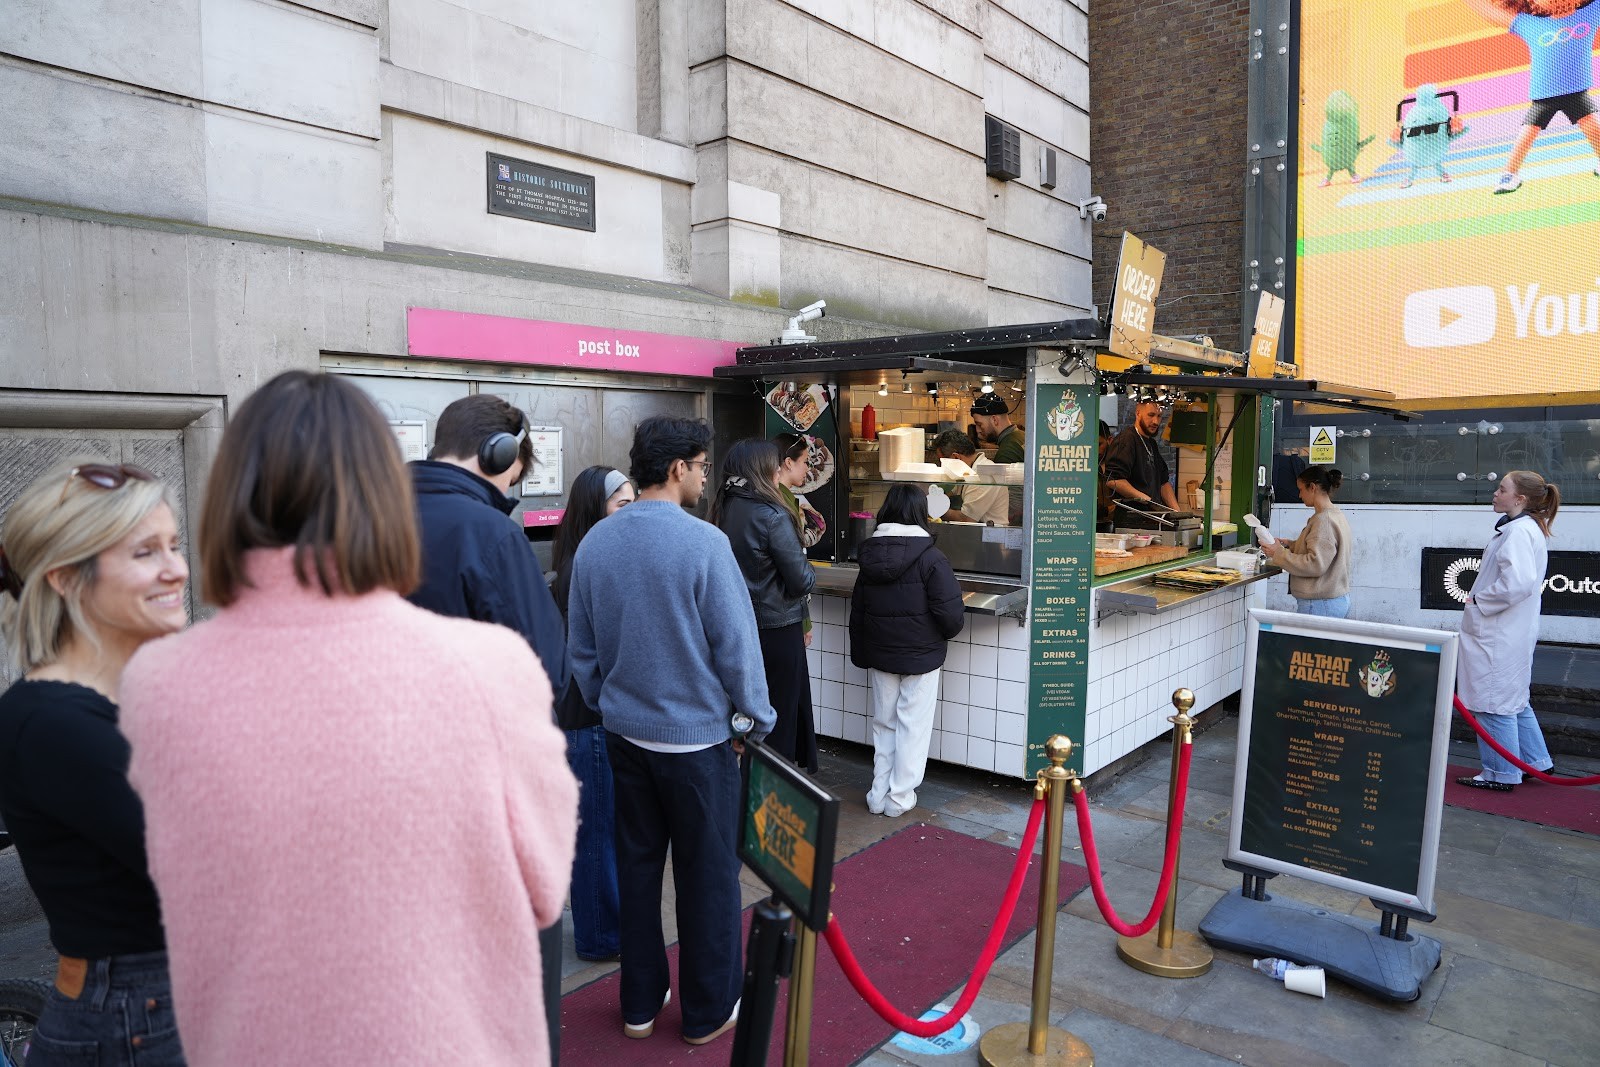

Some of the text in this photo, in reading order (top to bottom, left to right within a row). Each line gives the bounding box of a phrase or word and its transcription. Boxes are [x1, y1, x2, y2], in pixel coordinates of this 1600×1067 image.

[513, 171, 587, 196] HISTORIC SOUTHWARK
[524, 190, 543, 198] THOMAS
[518, 200, 544, 210] PRODUCED
[524, 196, 544, 204] PRINTED
[570, 206, 588, 214] ENGLISH
[1122, 264, 1156, 302] ORDER
[1505, 276, 1600, 339] You
[1120, 298, 1148, 332] HERE
[1258, 316, 1279, 340] COLLECT
[578, 338, 640, 358] post box
[1256, 340, 1273, 358] HERE
[1038, 458, 1092, 472] FALAFEL
[1289, 664, 1350, 688] FALAFEL
[1304, 700, 1360, 715] SERVED WITH
[1288, 707, 1392, 729] Hummus, Tomato, Lettuce, Carrot,
[1302, 716, 1321, 726] Turnip,
[1324, 720, 1341, 728] Tahini
[1343, 723, 1363, 732] Sauce,
[1365, 726, 1381, 735] Chilli
[1290, 738, 1314, 746] FALAFEL
[1314, 732, 1344, 744] WRAPS
[1289, 745, 1313, 753] FALAFEL
[1288, 758, 1316, 767] HALLOUMI
[1287, 773, 1311, 782] FALAFEL
[1312, 770, 1340, 781] BOXES
[1286, 780, 1315, 790] HALLOUMI
[766, 792, 806, 836] Order
[1284, 807, 1308, 816] FALAFEL
[1306, 802, 1340, 814] EXTRAS
[1306, 819, 1338, 832] DRINKS
[1309, 828, 1330, 838] DRINKS
